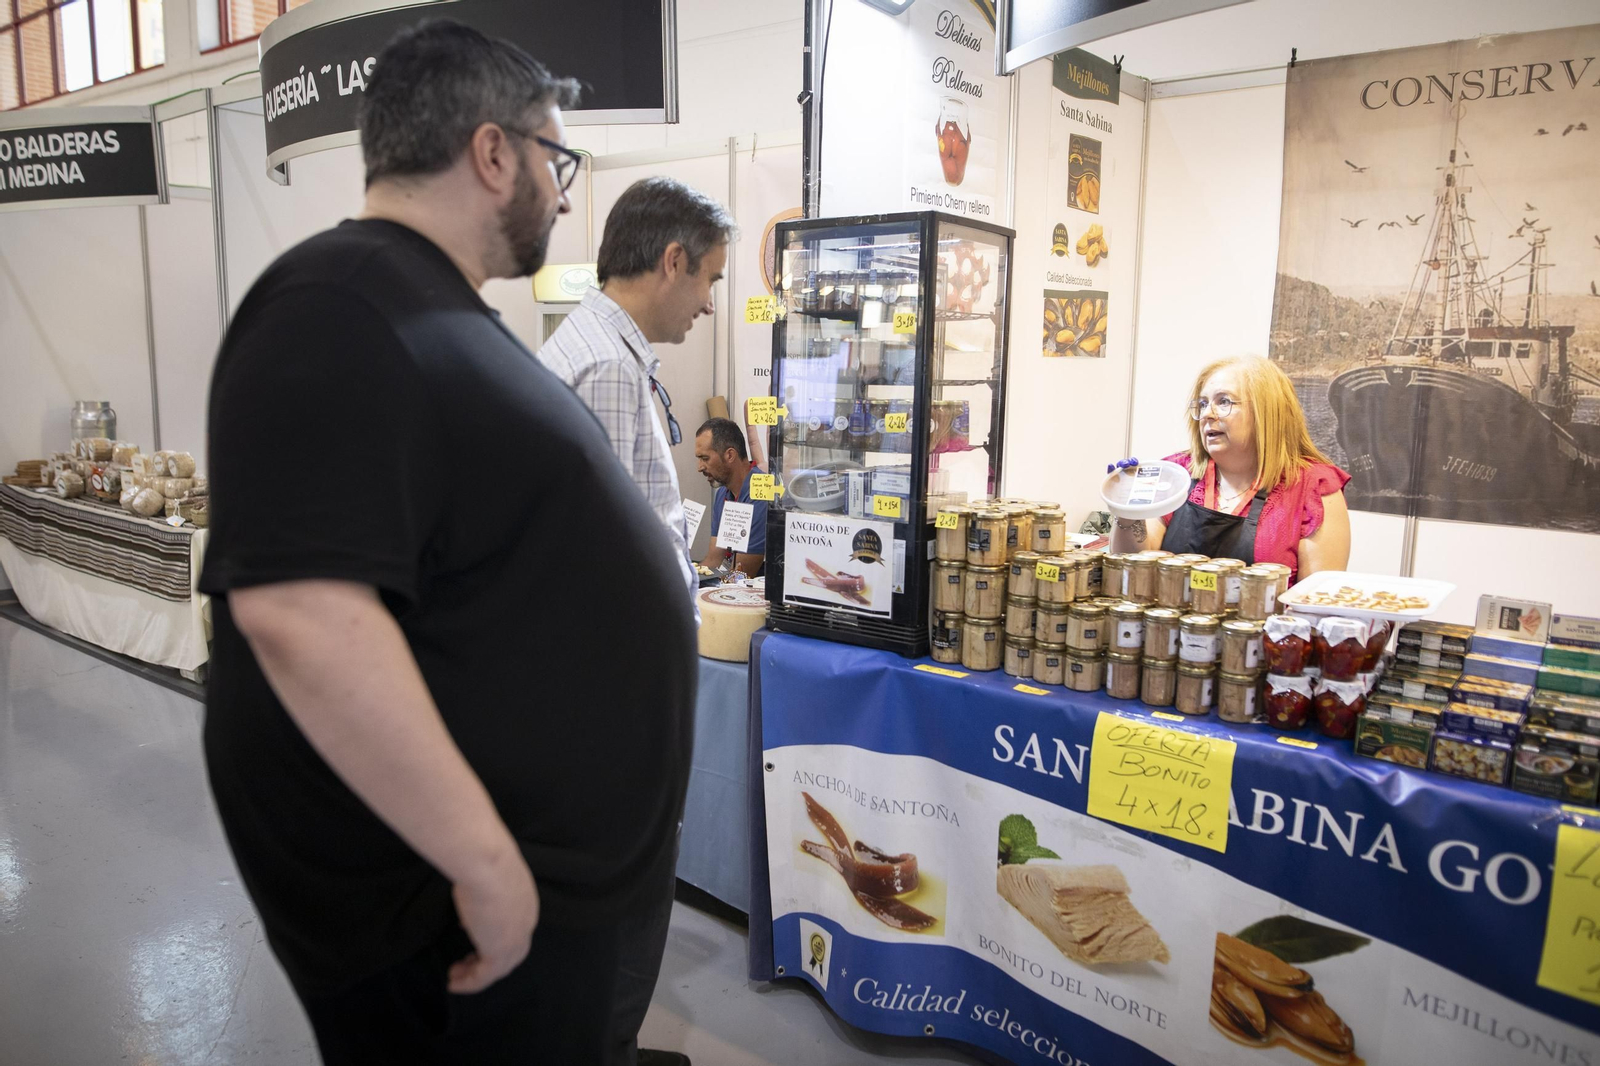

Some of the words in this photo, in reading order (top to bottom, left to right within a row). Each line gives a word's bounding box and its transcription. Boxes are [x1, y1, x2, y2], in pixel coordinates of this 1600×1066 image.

[935, 9, 983, 53] Delicias
[265, 65, 320, 122] QUESERÍA
[932, 56, 983, 98] Rellenas
[1067, 63, 1110, 97] Mejillones
[1360, 56, 1600, 110] CONSERV
[1060, 99, 1083, 126] Santa
[1085, 110, 1113, 135] Sabina
[14, 129, 120, 160] BALDERAS
[8, 161, 86, 189] MEDINA
[910, 186, 943, 208] Pimiento
[944, 193, 967, 215] Cherry
[968, 200, 990, 217] relleno
[1046, 271, 1064, 284] Calidad
[1065, 273, 1093, 287] Seleccionada
[789, 520, 835, 537] ANCHOAS
[837, 525, 850, 536] DE
[789, 533, 833, 548] SANTOÑA
[1106, 724, 1212, 764] OFERTA
[1108, 751, 1212, 789] BONITO
[793, 770, 853, 799] ANCHOA
[854, 790, 867, 808] DE
[870, 795, 960, 827] SANTOÑA
[978, 934, 1044, 980] BONITO
[1050, 970, 1087, 998] DEL
[1094, 986, 1167, 1031] NORTE
[853, 977, 967, 1015] Calidad
[970, 1004, 1091, 1066] seleccio
